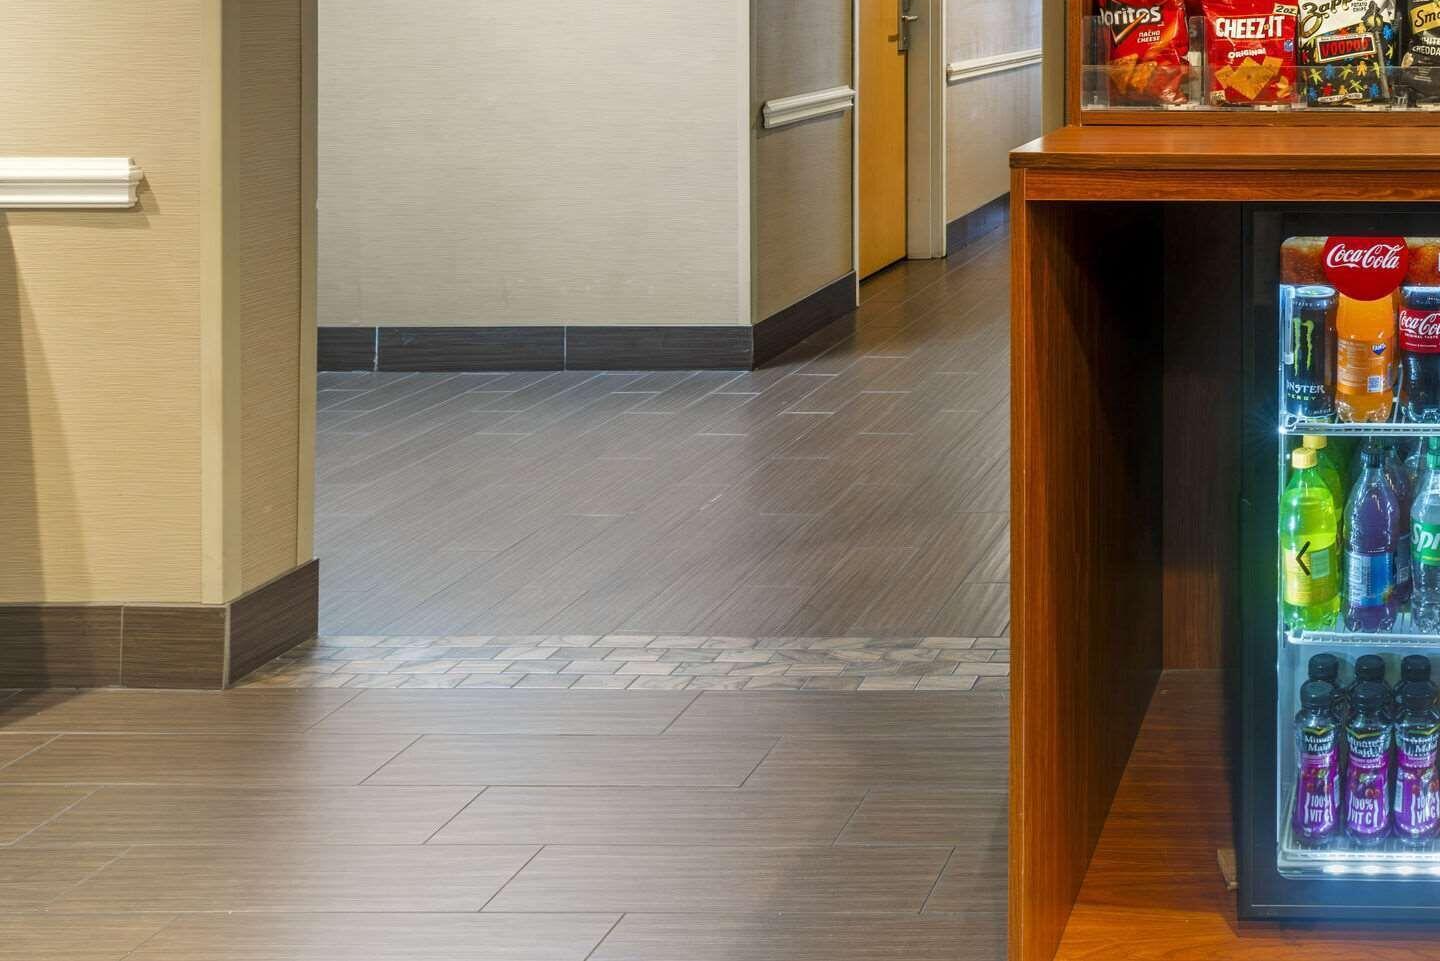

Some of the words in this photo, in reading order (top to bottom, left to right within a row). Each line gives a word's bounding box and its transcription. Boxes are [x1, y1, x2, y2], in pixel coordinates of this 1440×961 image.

[1228, 48, 1266, 59] ORIGINAL
[1321, 38, 1369, 56] VOODOO
[1326, 243, 1404, 270] Coca-Cola
[1288, 382, 1326, 394] NSTER
[1352, 798, 1374, 810] 100%
[1310, 809, 1323, 822] VIT
[1352, 810, 1364, 824] VIT
[1366, 811, 1372, 824] C
